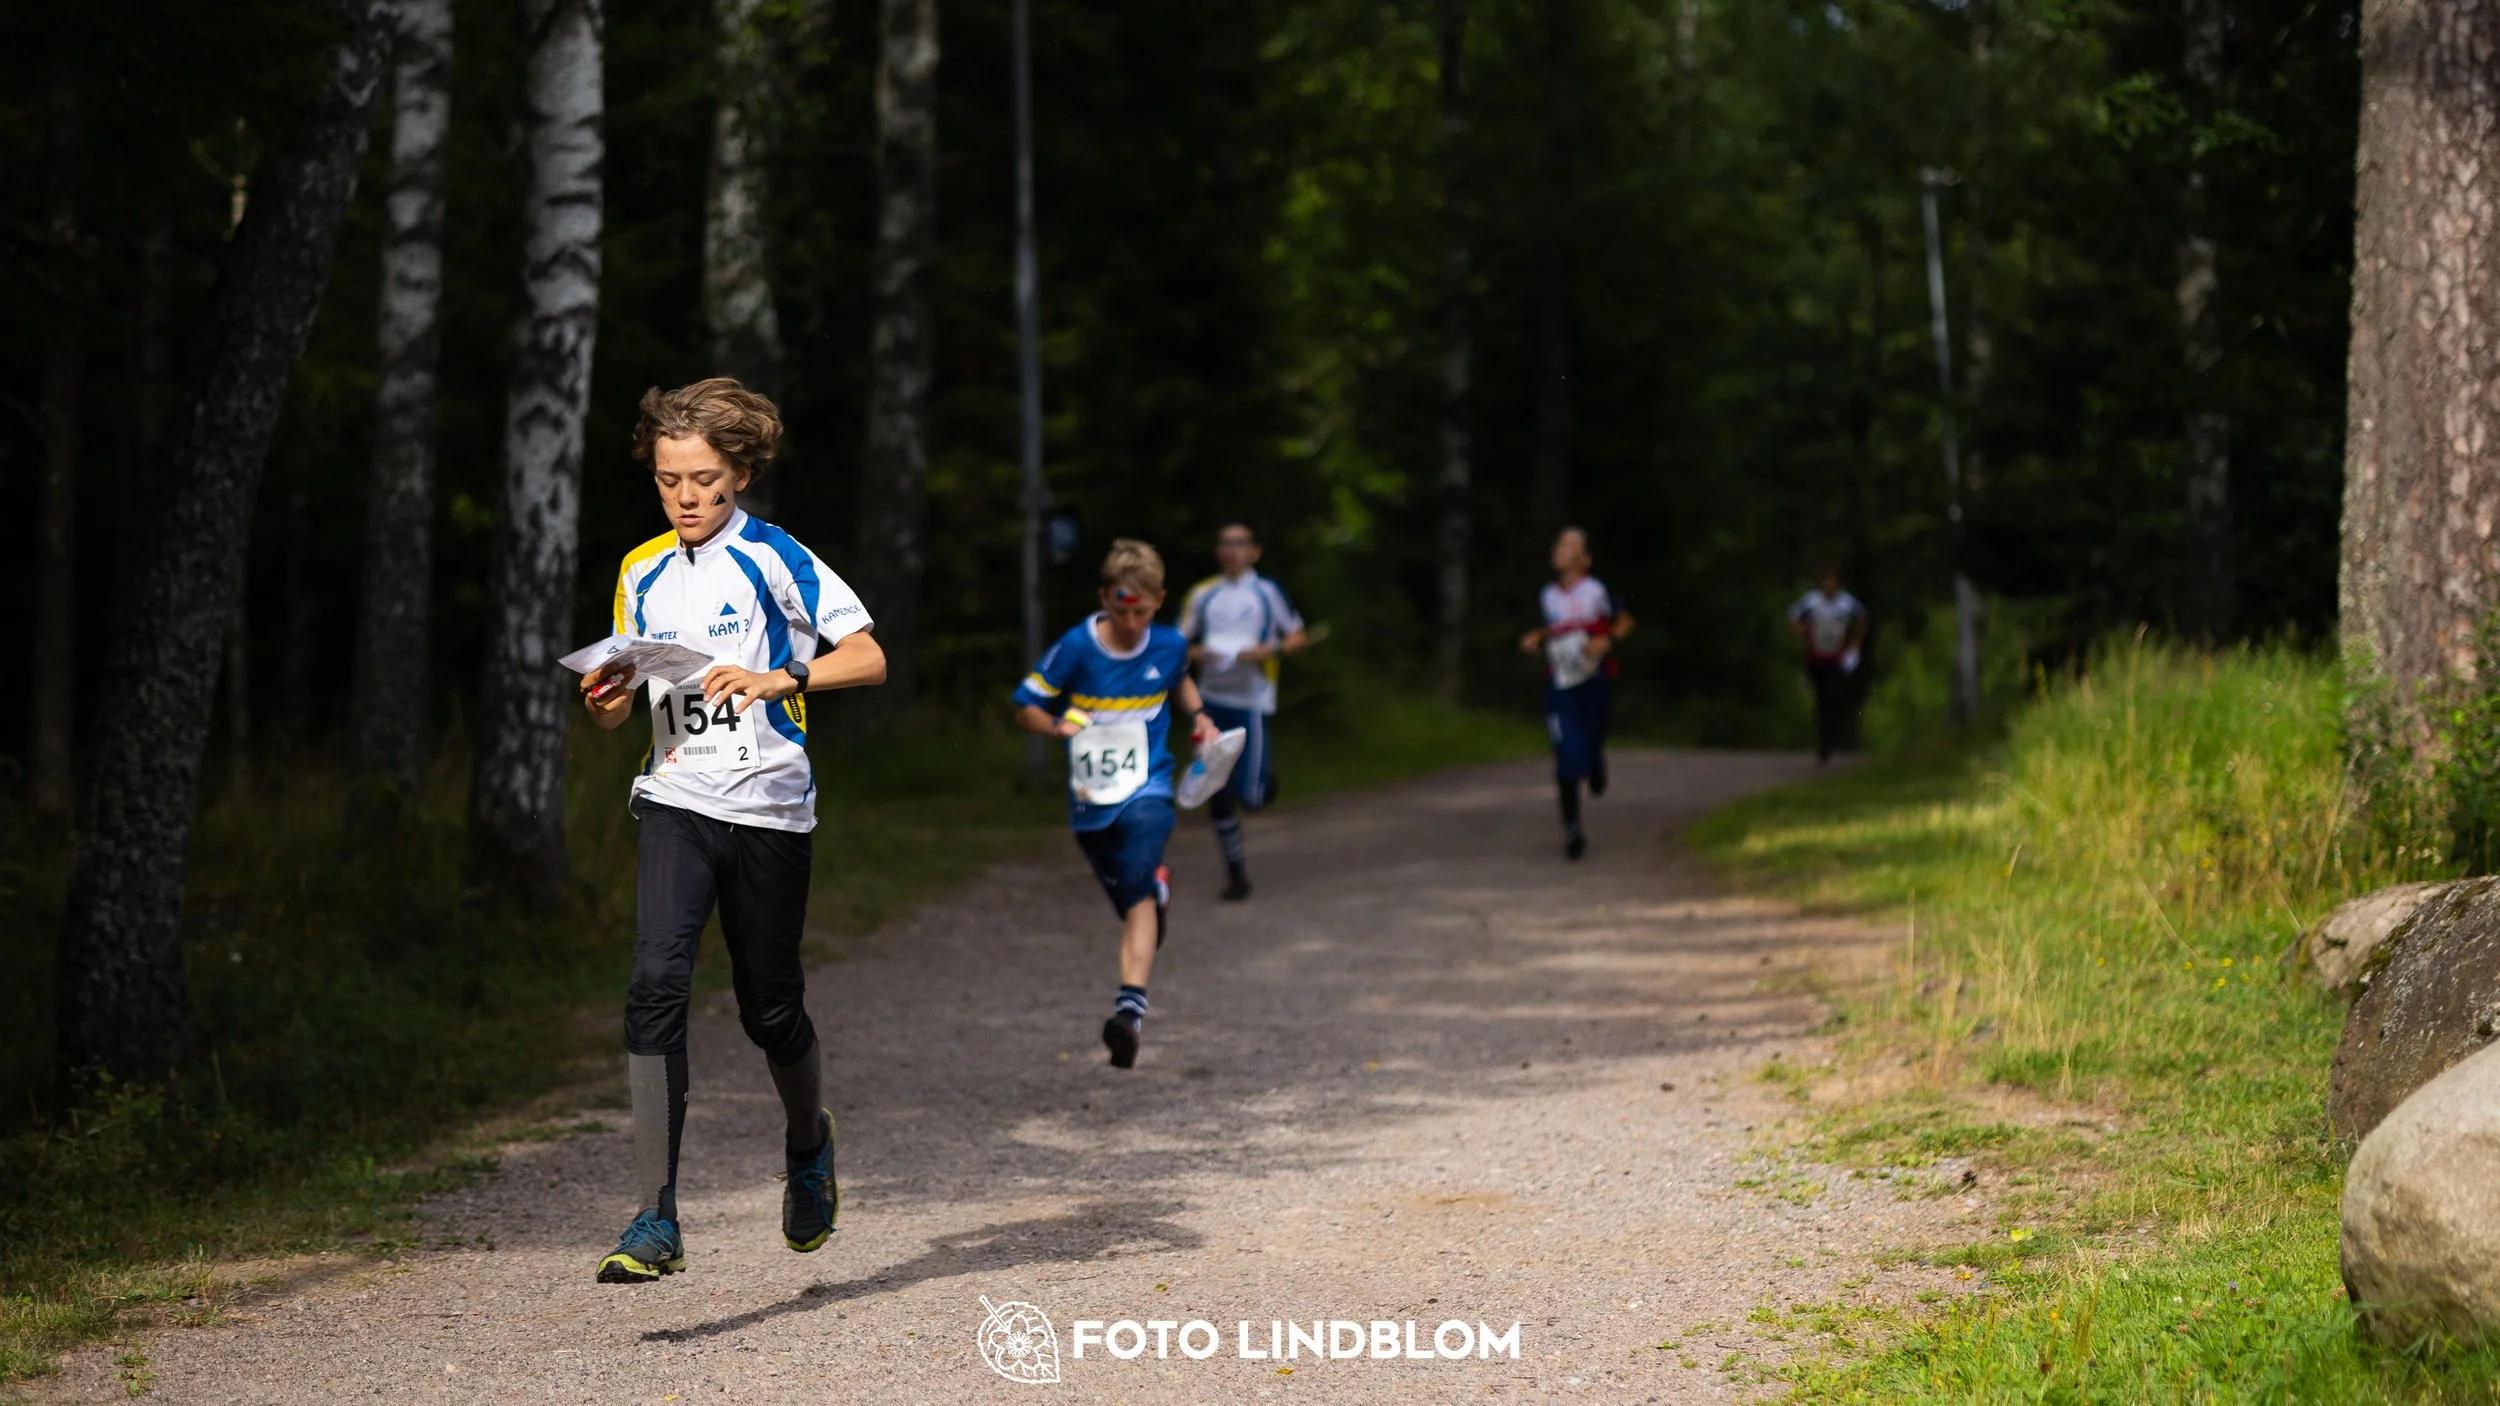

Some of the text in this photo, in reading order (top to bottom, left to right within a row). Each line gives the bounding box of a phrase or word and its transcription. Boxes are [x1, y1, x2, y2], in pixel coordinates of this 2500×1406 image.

[708, 621, 739, 637] KAM
[659, 693, 741, 735] 154
[738, 746, 749, 761] 2
[1078, 746, 1138, 778] 154
